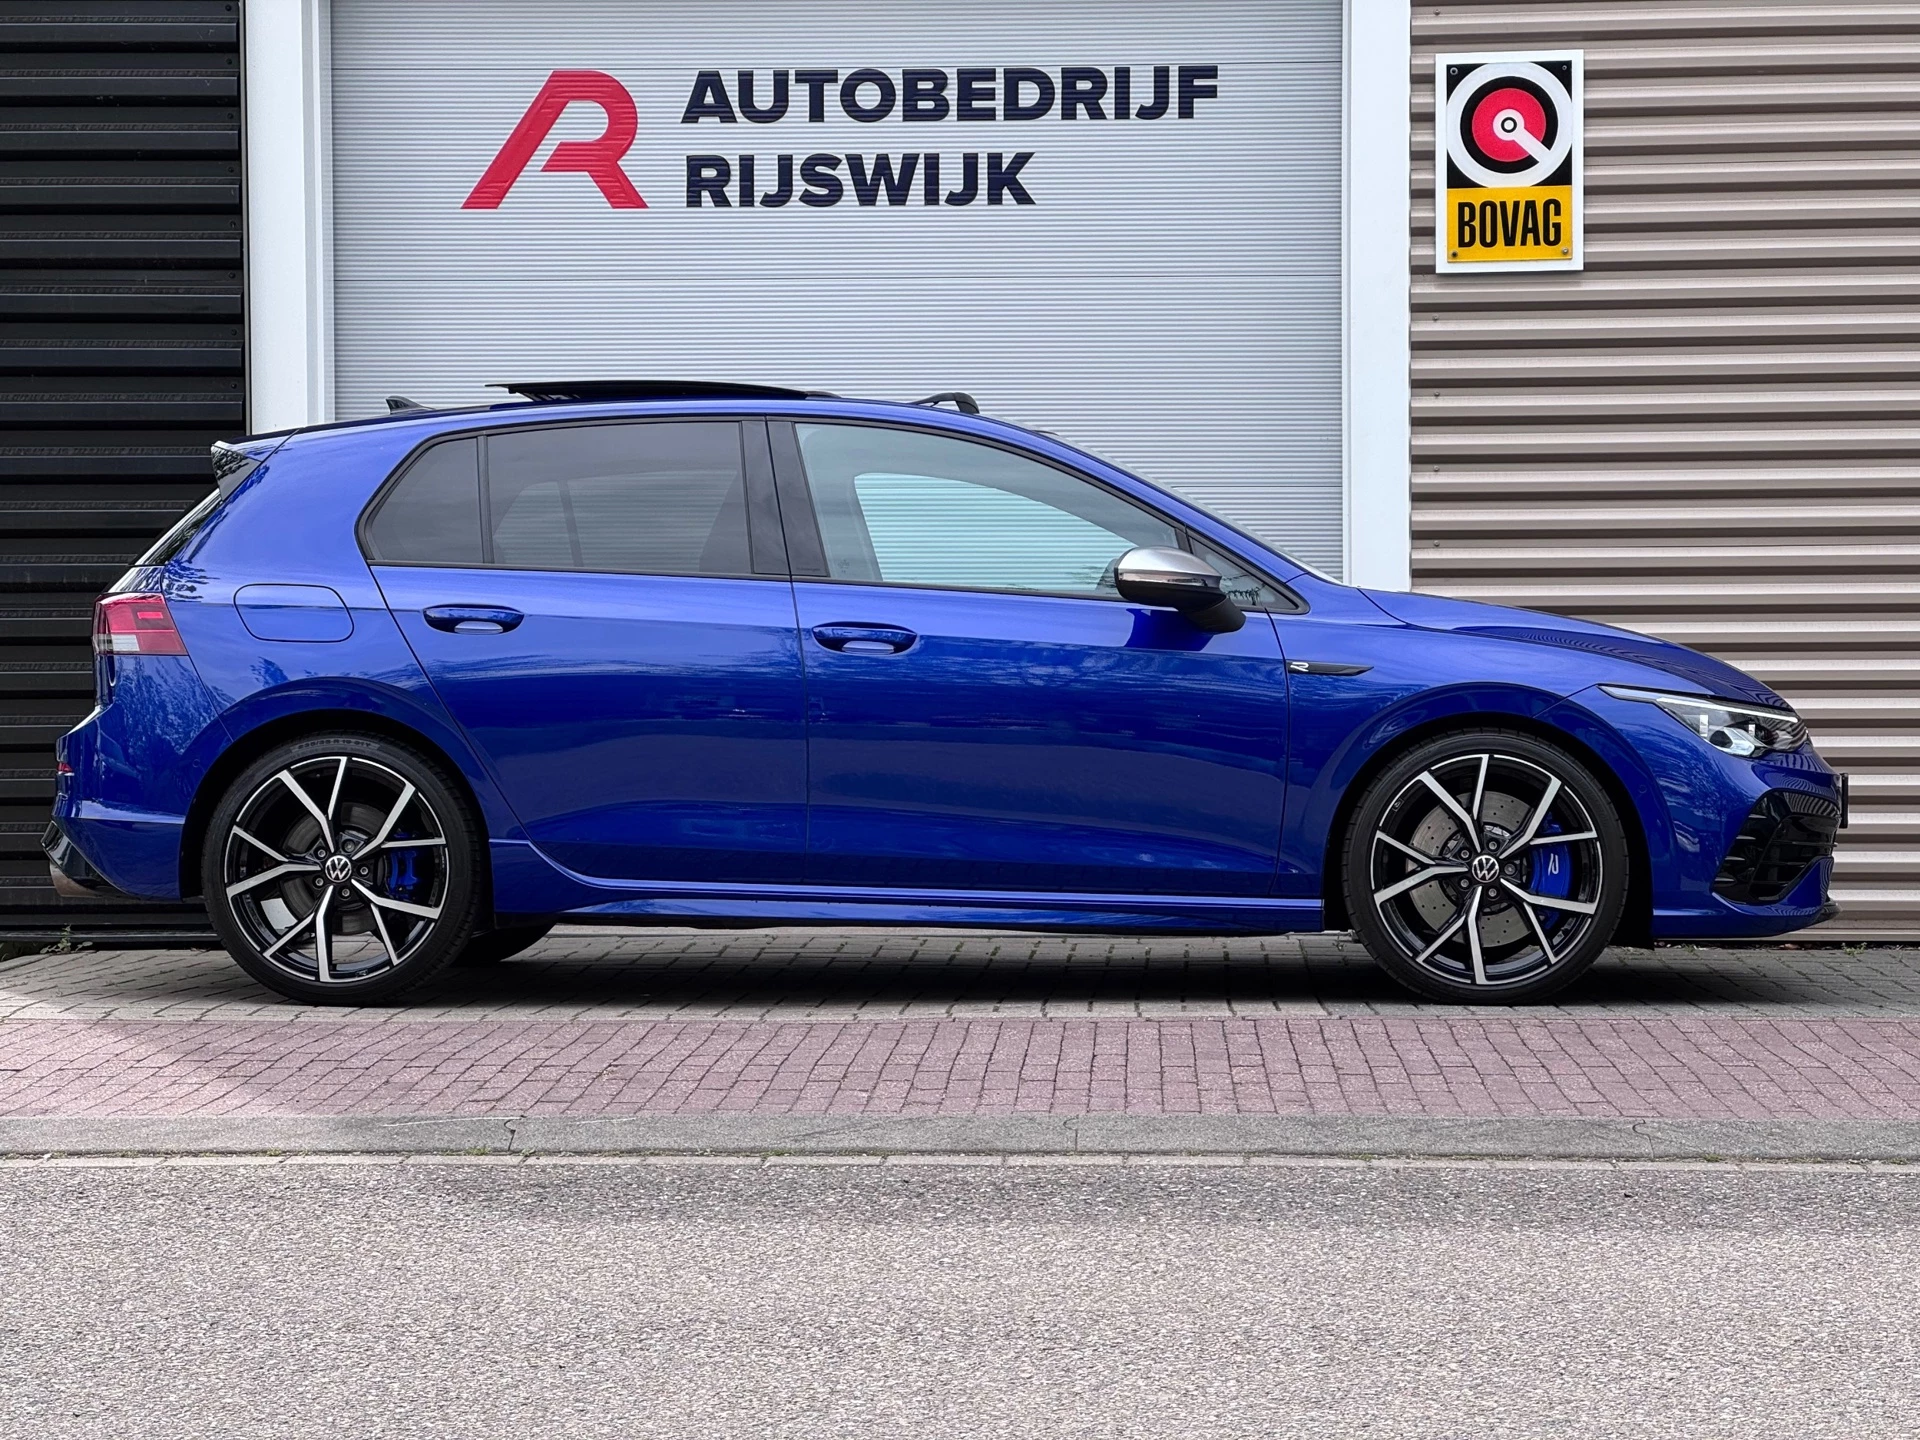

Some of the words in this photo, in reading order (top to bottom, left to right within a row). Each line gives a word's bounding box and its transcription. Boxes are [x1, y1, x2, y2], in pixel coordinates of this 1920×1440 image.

[680, 64, 1220, 124] AUTOBEDRIJF
[685, 151, 1037, 209] RIJSWIJK
[1457, 198, 1562, 248] BOVAG
